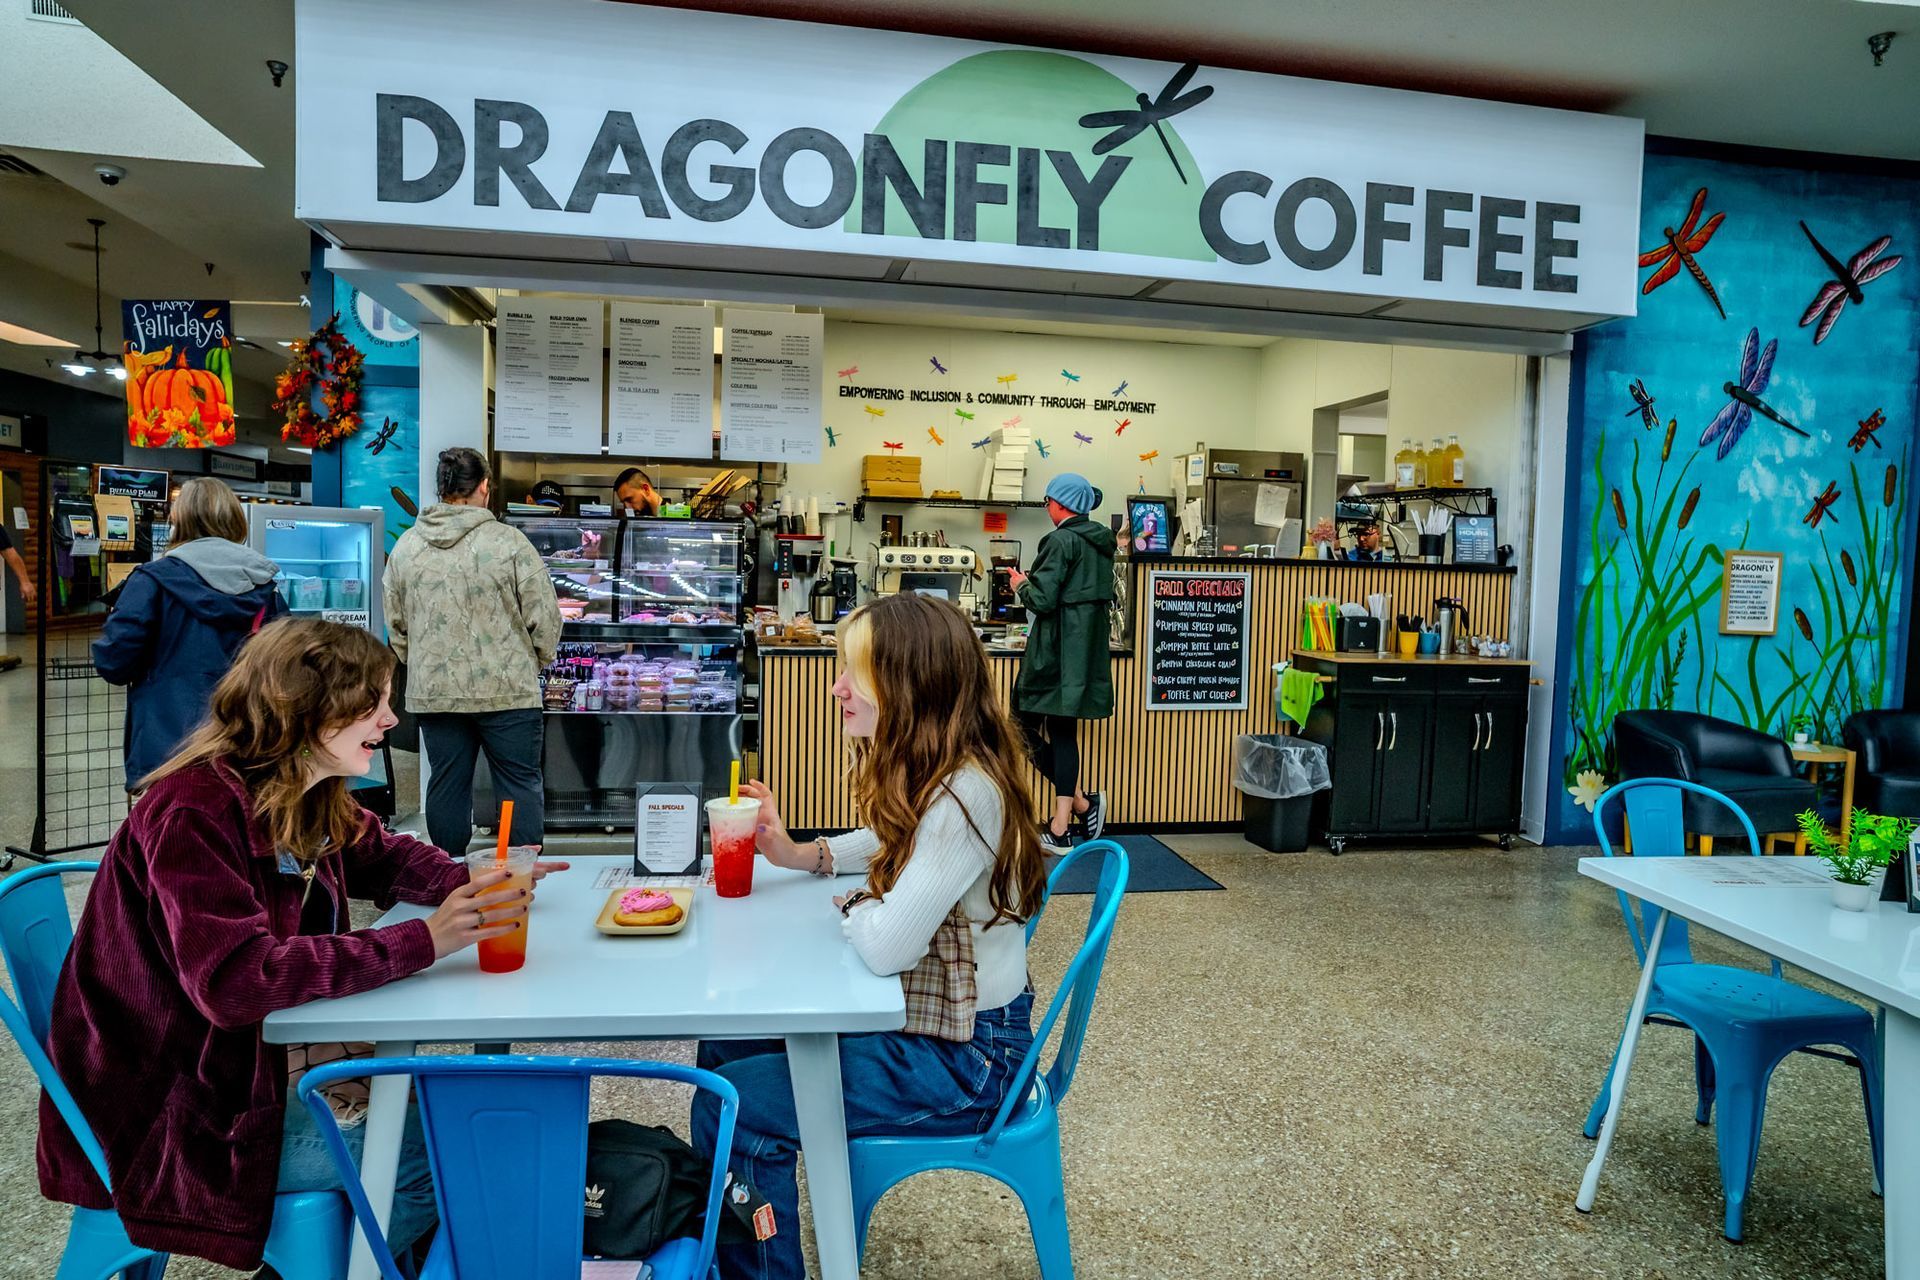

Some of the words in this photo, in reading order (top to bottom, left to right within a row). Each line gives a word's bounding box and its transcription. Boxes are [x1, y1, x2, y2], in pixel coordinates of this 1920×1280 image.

[376, 92, 1134, 251] DRAGONFLY
[1198, 170, 1581, 294] COFFEE
[152, 300, 195, 312] HAPPY
[130, 304, 224, 358] fallidays
[366, 334, 394, 348] PEOPLE
[839, 386, 904, 401] EMPOWERING
[910, 390, 961, 402] INCLUSION
[966, 392, 974, 404] &
[978, 393, 1035, 406] COMMUNITY
[1040, 396, 1086, 410] THROUGH
[1094, 399, 1156, 414] EMPLOYMENT
[1155, 580, 1185, 596] FALL
[1187, 580, 1245, 596] SPECIALS
[1161, 600, 1195, 612] CINNAMON
[1197, 601, 1212, 612] ROLL
[1161, 620, 1189, 631] PUMPKIN
[1192, 622, 1214, 632] SPICED
[1217, 623, 1232, 632] LATTE
[1161, 641, 1188, 651] PUMPKIN
[1191, 642, 1210, 650] TOFFEE
[1213, 642, 1231, 650] LATTE
[1158, 676, 1175, 685] BLACK
[1167, 690, 1190, 700] TOFFEE
[1193, 690, 1207, 700] NUT
[1209, 691, 1231, 700] CIDER
